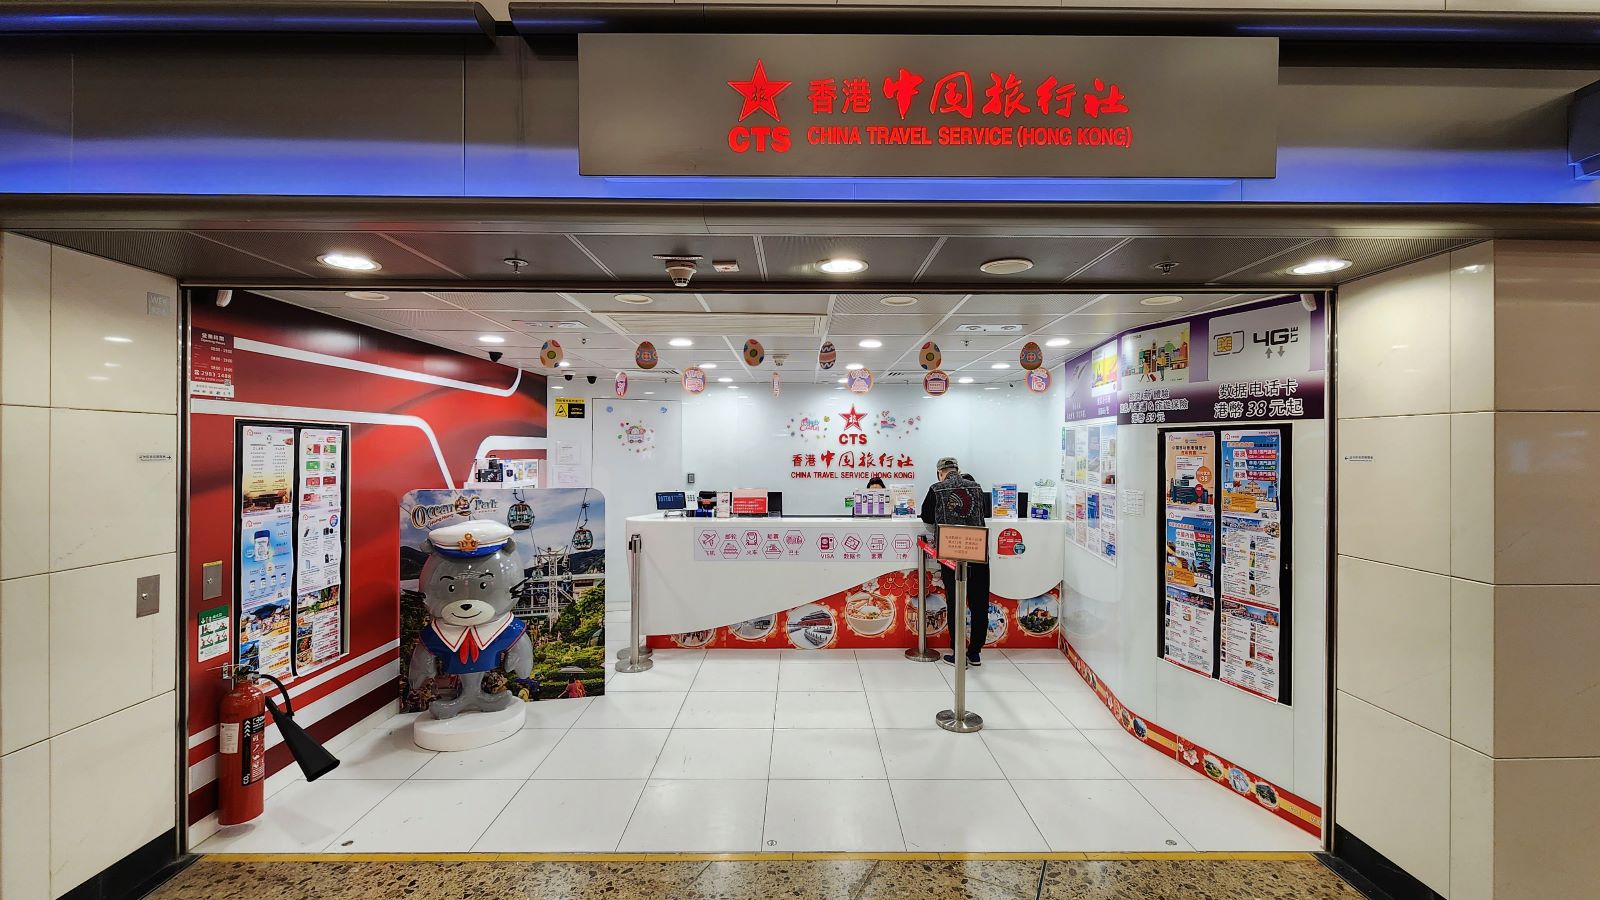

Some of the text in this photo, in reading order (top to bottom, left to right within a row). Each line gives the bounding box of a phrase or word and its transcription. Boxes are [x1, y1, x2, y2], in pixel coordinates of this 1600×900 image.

[728, 126, 792, 153] CTS
[808, 126, 1133, 148] CHINA TRAVEL SERVICE (HONG KONG)
[1253, 326, 1298, 346] 4G LTE
[1218, 378, 1298, 399] 数据电话卡
[1145, 412, 1156, 423] 59
[1214, 398, 1304, 418] 港幣 38 元起
[839, 433, 868, 445] CTS
[791, 471, 915, 480] CHINA TRAVEL SERVICE (HONG KONG)
[411, 498, 497, 529] Ocean Park
